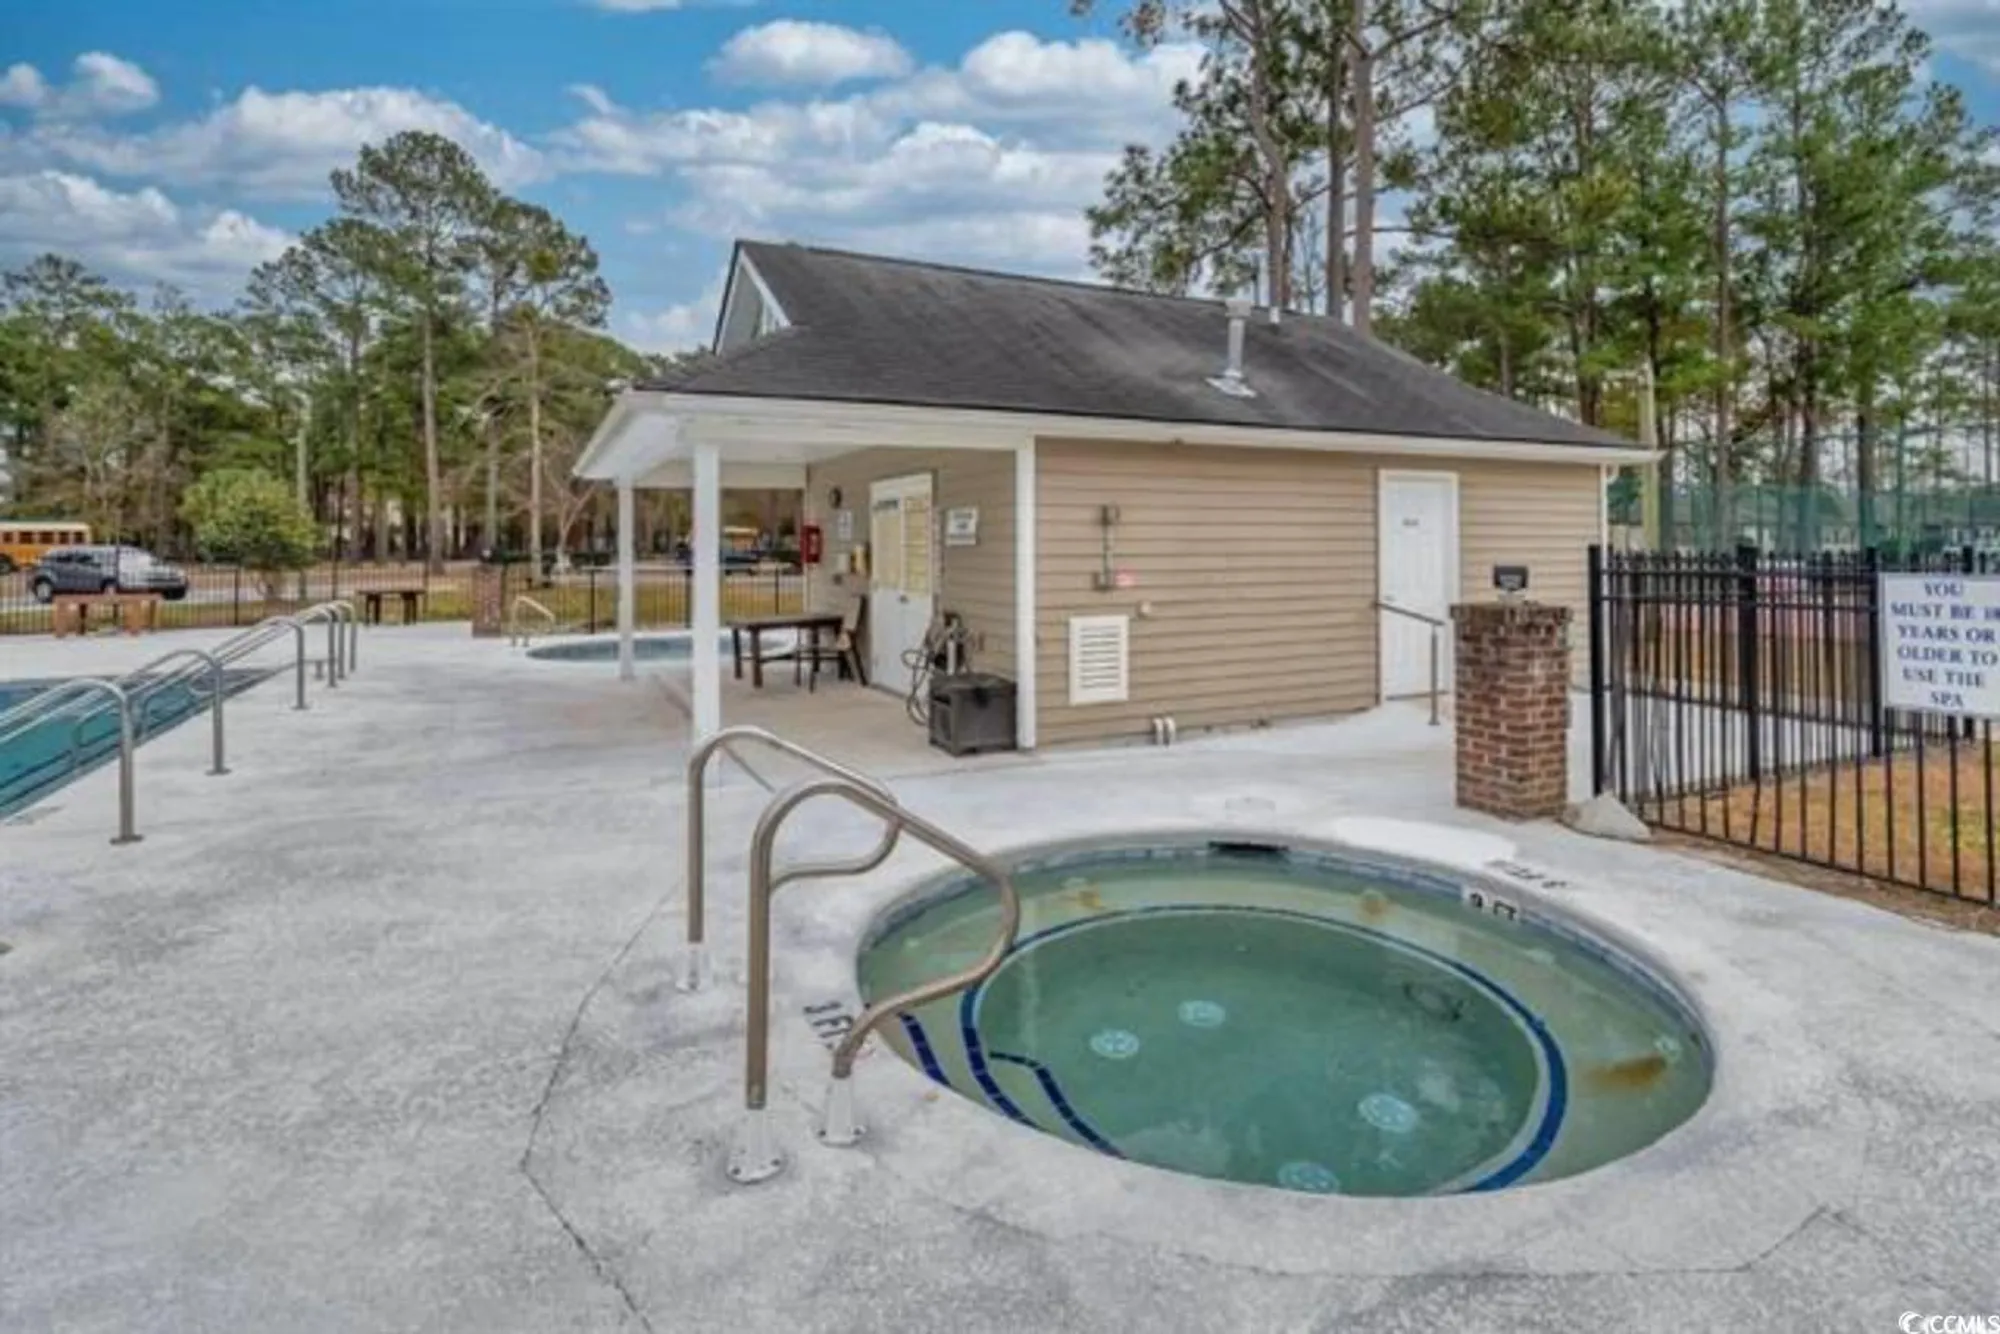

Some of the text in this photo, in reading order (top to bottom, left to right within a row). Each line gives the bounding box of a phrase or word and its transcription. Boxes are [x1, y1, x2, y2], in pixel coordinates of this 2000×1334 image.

[1924, 582, 1963, 597] YOU
[1891, 602, 1942, 618] MUST
[1950, 604, 1975, 620] BE
[1897, 624, 1996, 643] YEARS OR
[1897, 646, 1998, 666] OLDER TO
[1903, 667, 1984, 688] USE THE
[1931, 691, 1964, 707] SPA
